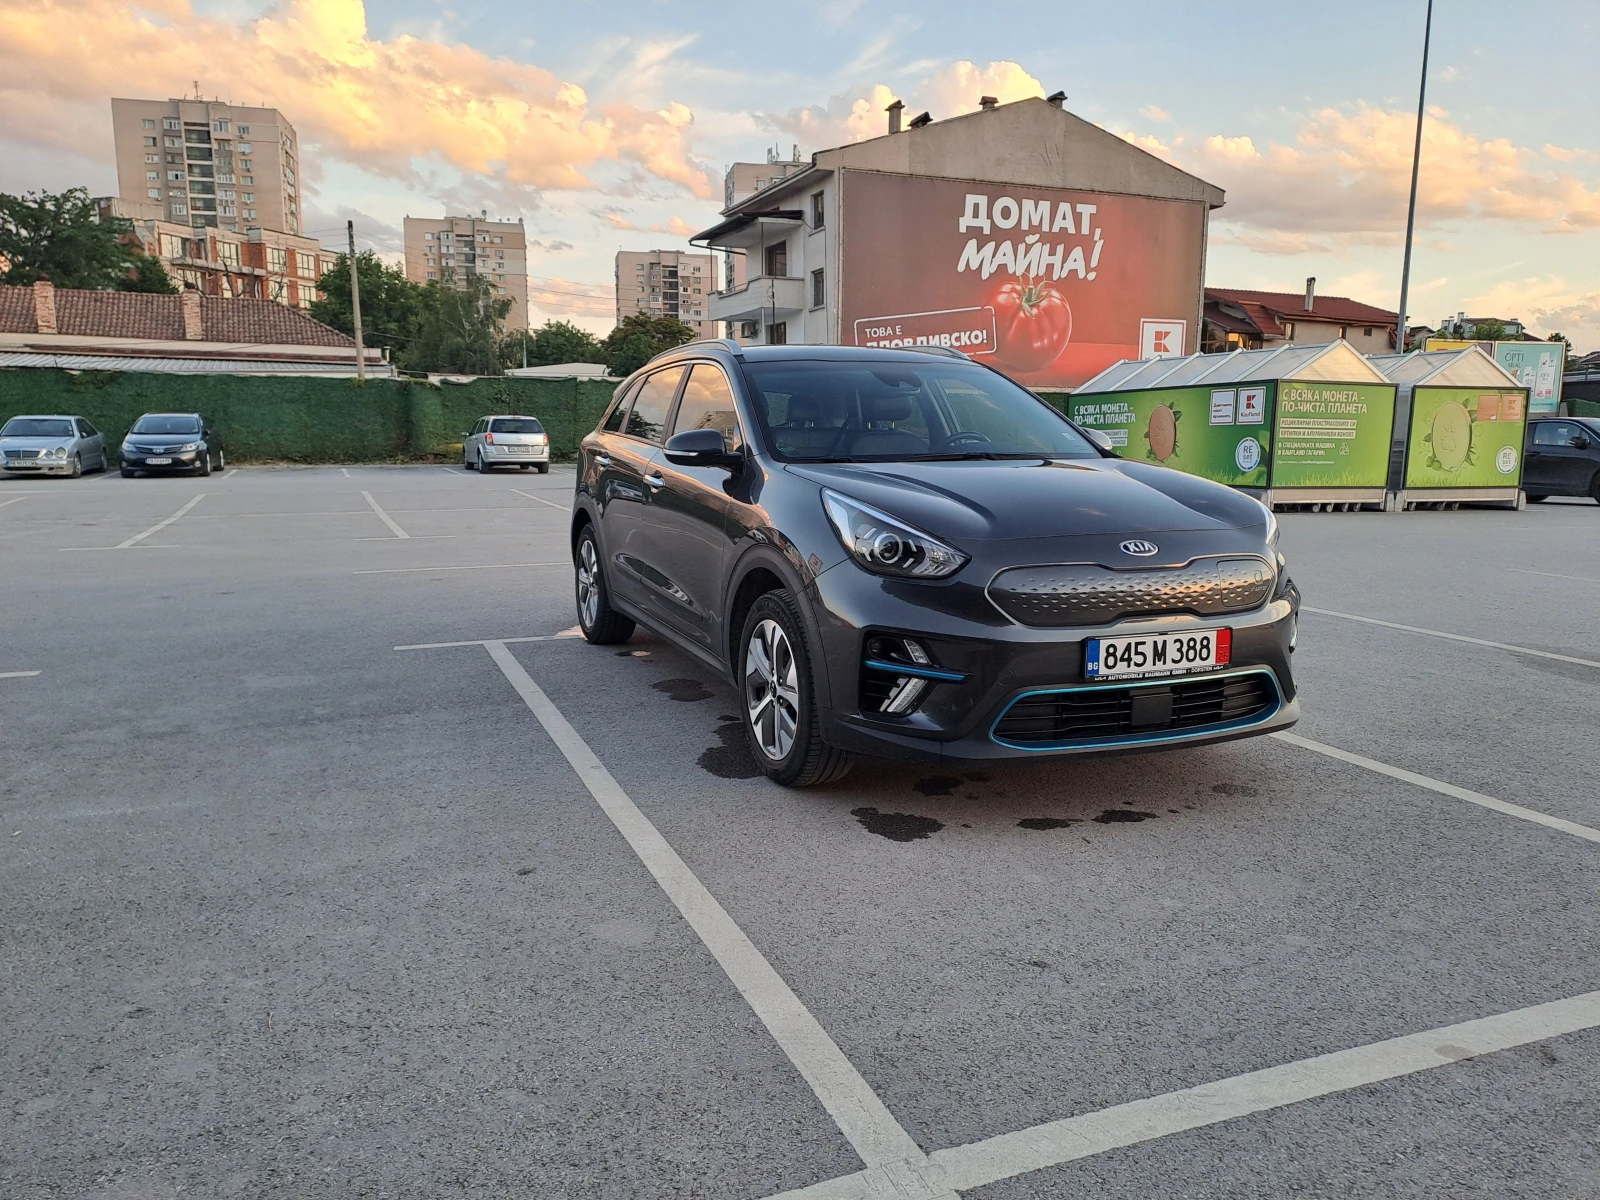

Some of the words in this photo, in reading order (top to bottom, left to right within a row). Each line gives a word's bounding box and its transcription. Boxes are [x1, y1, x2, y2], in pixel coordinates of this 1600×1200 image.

[959, 193, 1101, 240] ДОМАТ,
[957, 233, 1104, 281] МАЙНА!
[865, 326, 893, 338] ТОВА
[896, 325, 902, 335] Е
[1505, 352, 1524, 362] OPTI
[1283, 389, 1288, 400] С
[1291, 389, 1319, 401] ВСЯКА
[1322, 390, 1358, 402] МОНЕТА
[1074, 405, 1079, 415] С
[1080, 404, 1100, 415] ВСЯКА
[1101, 402, 1128, 413] МОНЕТА
[1282, 401, 1325, 413] ПО-ЧИСТА
[1328, 403, 1367, 414] ПЛАНЕТА
[1074, 414, 1104, 426] ПО-ЧИСТА
[1105, 412, 1136, 424] ПЛАНЕТА
[1126, 542, 1155, 552] KIA
[1104, 641, 1147, 670] 845
[1152, 639, 1167, 666] M
[1171, 636, 1211, 664] 388
[1087, 662, 1099, 671] BG
[1144, 670, 1171, 678] BAUMANN
